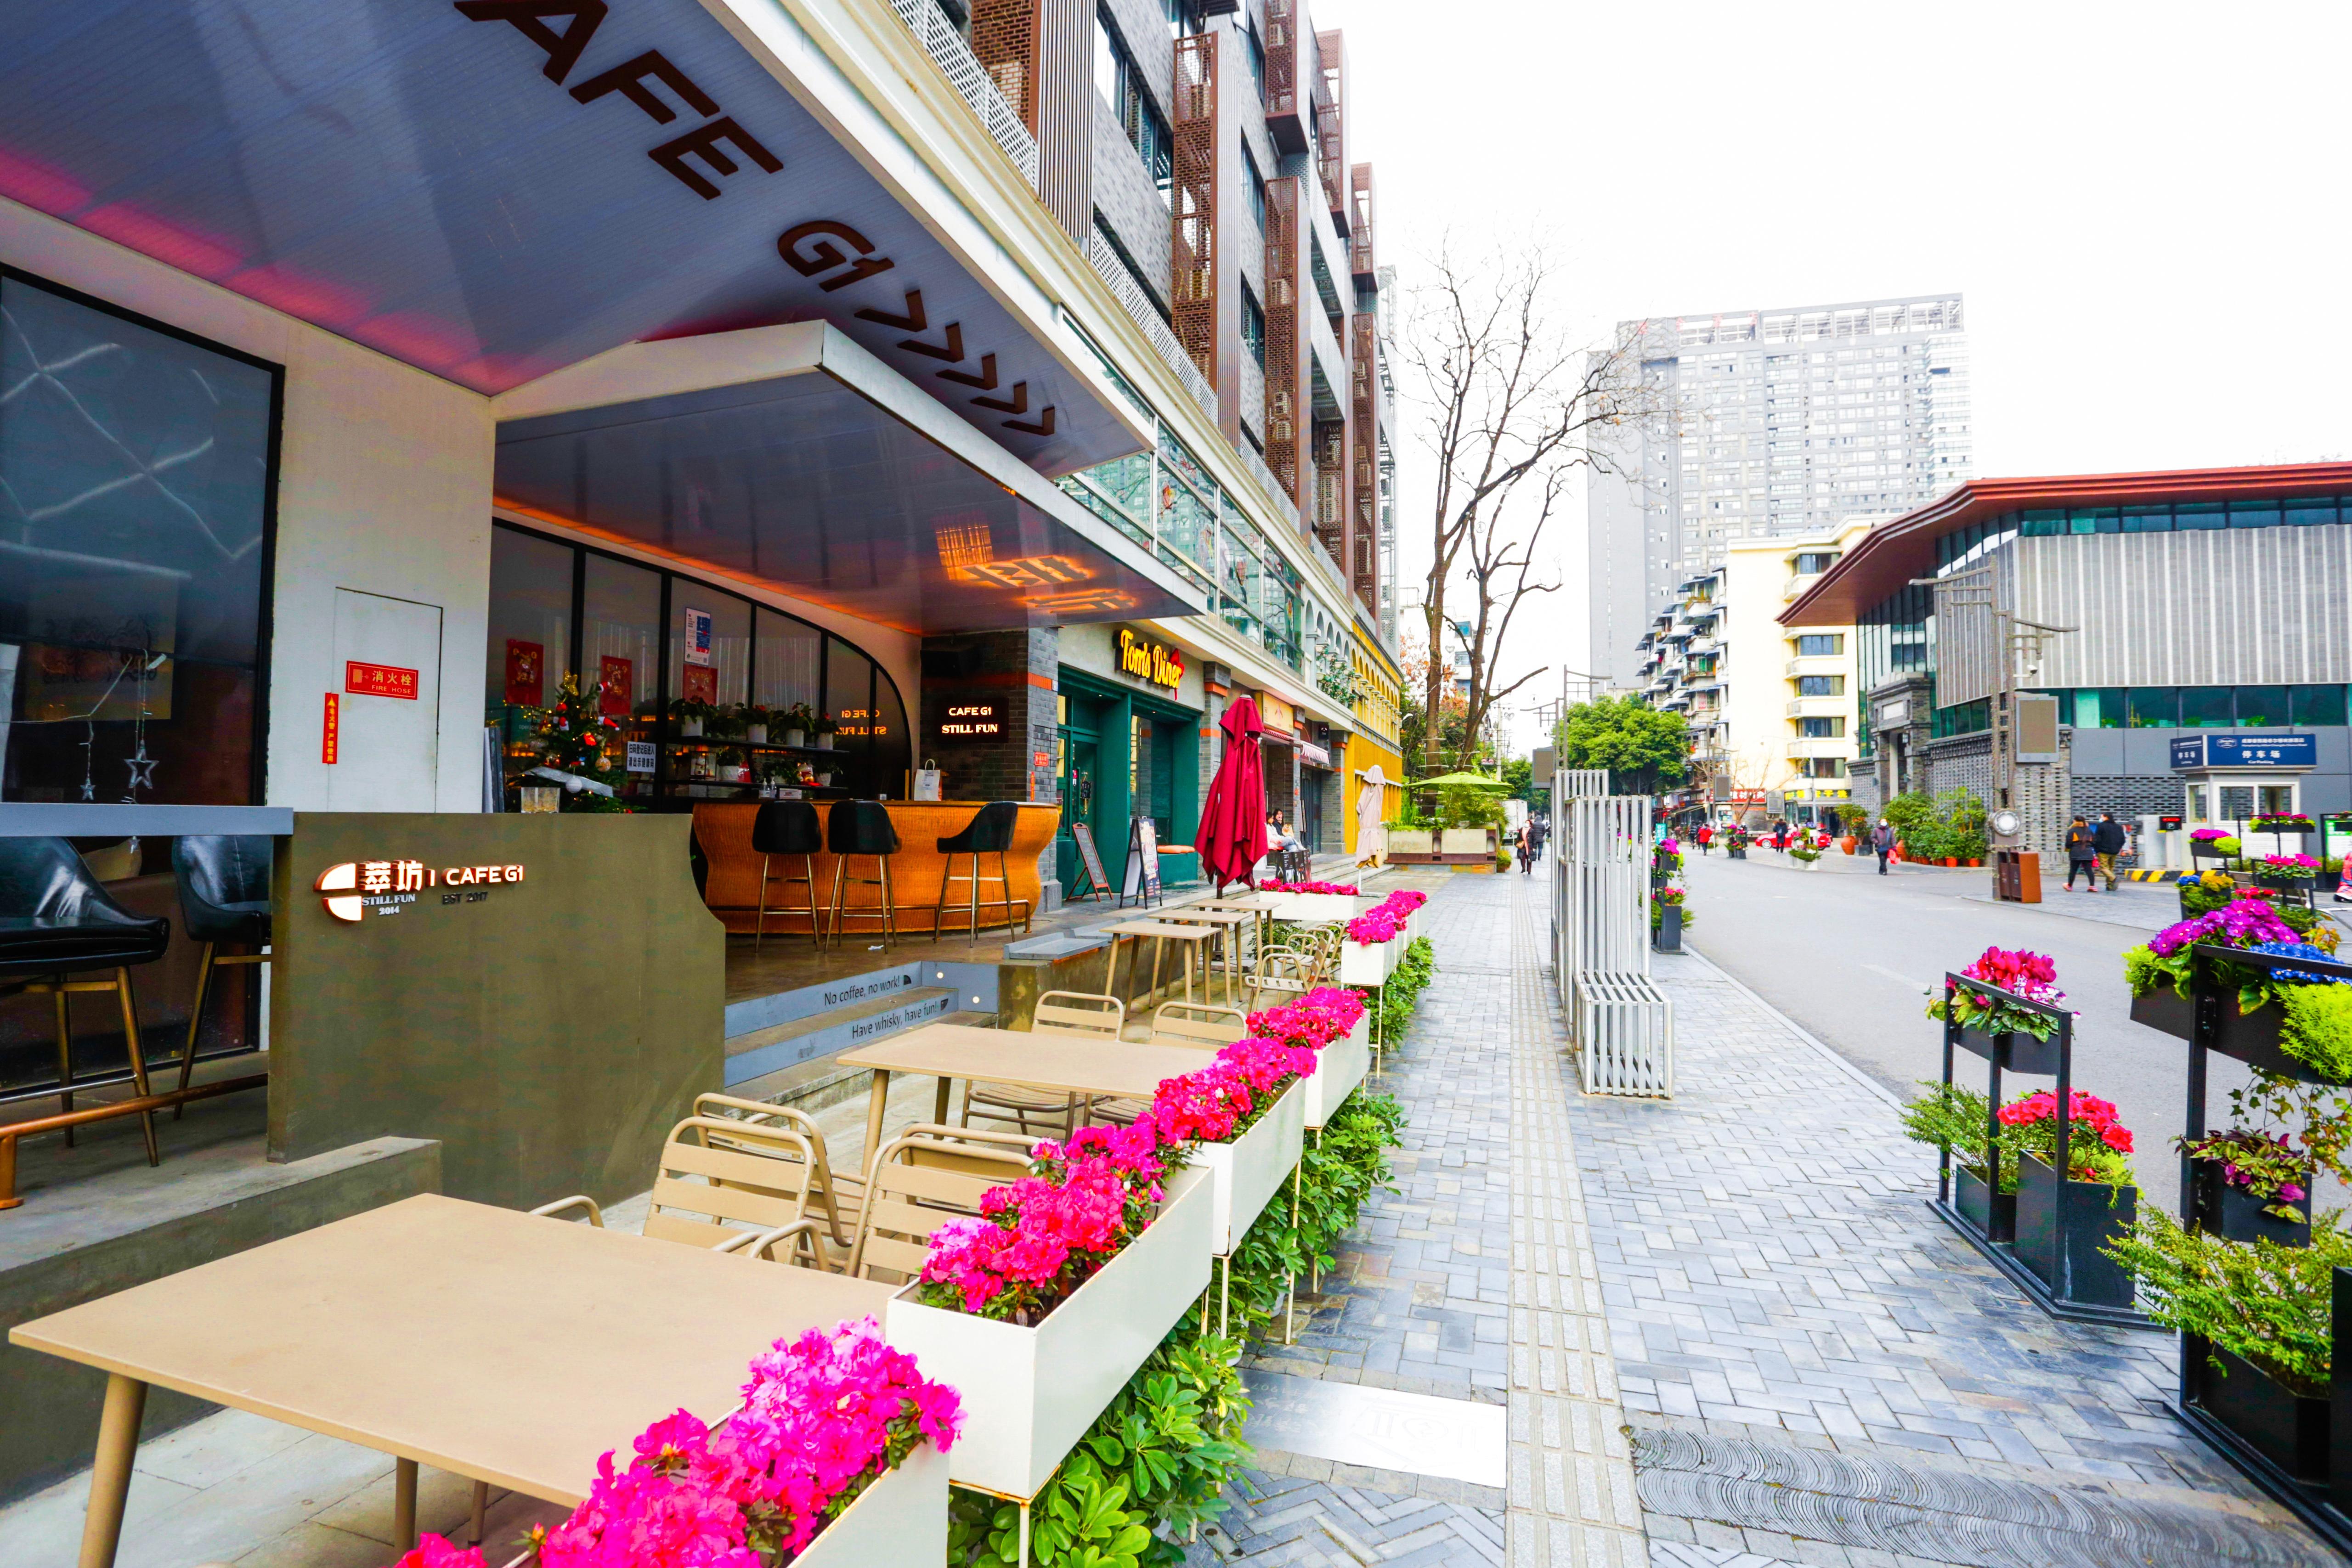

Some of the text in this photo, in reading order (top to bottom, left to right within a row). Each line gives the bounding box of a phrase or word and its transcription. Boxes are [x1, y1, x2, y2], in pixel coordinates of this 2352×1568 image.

[777, 220, 894, 293] G1
[1121, 629, 1182, 689] Tom's Diner
[372, 670, 412, 686] 消火栓
[949, 707, 991, 716] CAFE G1
[942, 724, 998, 733] STILL FUN
[443, 864, 524, 886] CAFE G1
[362, 894, 415, 906] STILL FUN
[442, 893, 462, 905] EST
[379, 905, 400, 915] 2014
[825, 975, 900, 1006] No coffee, no work!
[852, 1001, 937, 1039] Have whisky, have fun!
